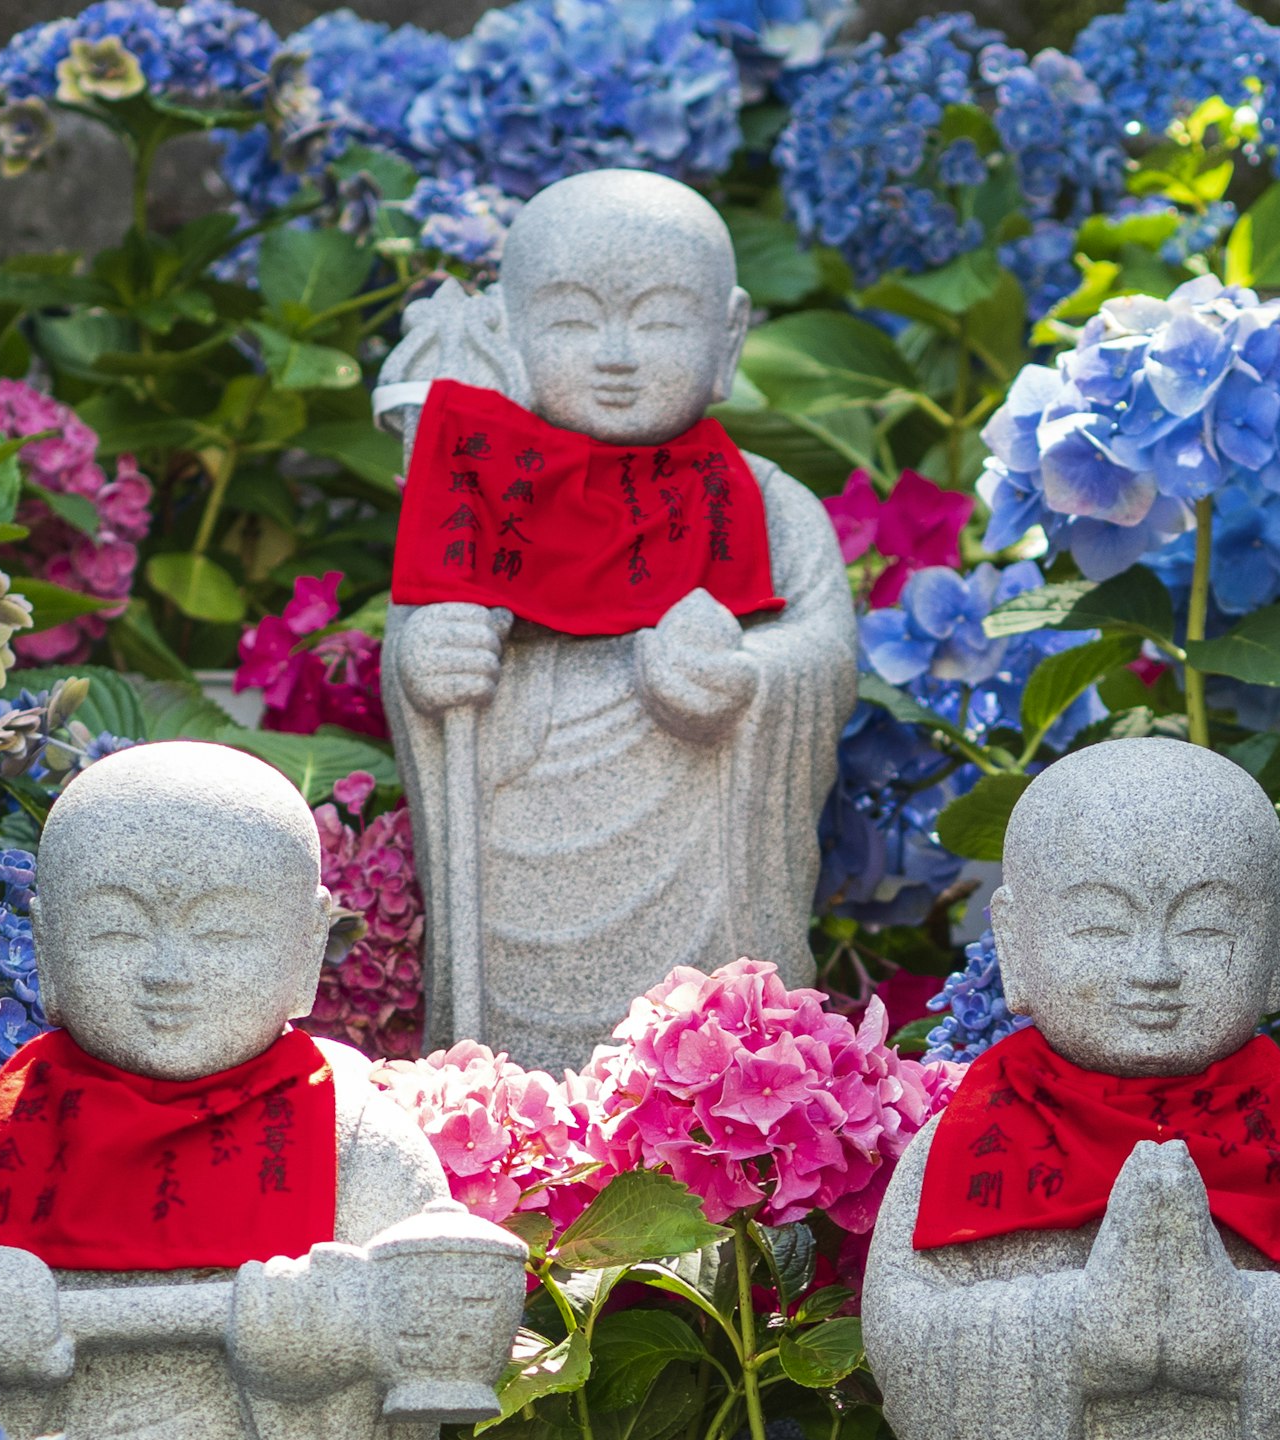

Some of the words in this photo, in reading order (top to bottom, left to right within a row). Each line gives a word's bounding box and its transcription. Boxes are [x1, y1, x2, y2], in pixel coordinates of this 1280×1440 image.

[440, 431, 494, 571] 遍照金剛
[491, 447, 546, 582] 南無大師
